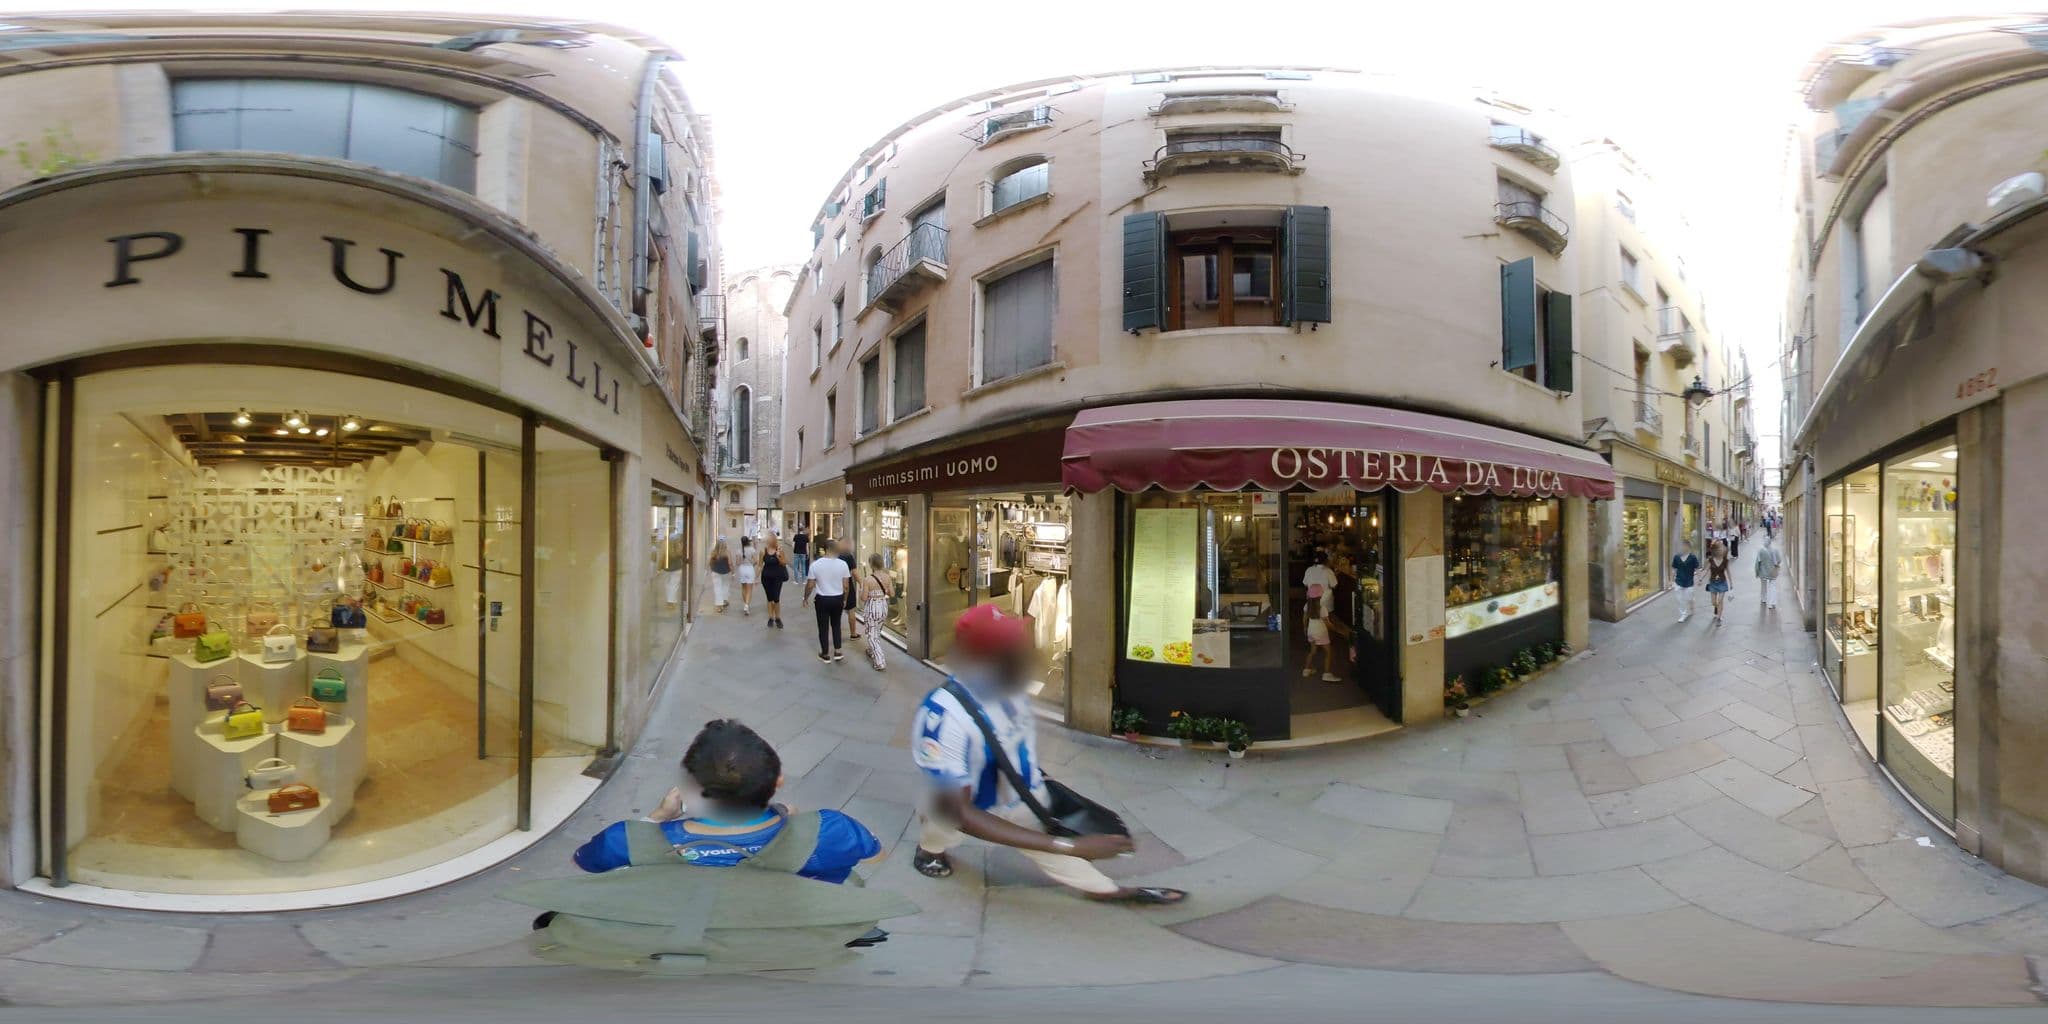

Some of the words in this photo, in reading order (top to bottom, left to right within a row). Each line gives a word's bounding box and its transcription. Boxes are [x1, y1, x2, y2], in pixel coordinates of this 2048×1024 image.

[104, 228, 622, 415] PIUMELLI
[946, 455, 998, 477] UOMO
[1271, 447, 1450, 485] OSTERIA
[1465, 460, 1501, 487] DA
[1512, 466, 1563, 491] LUCA
